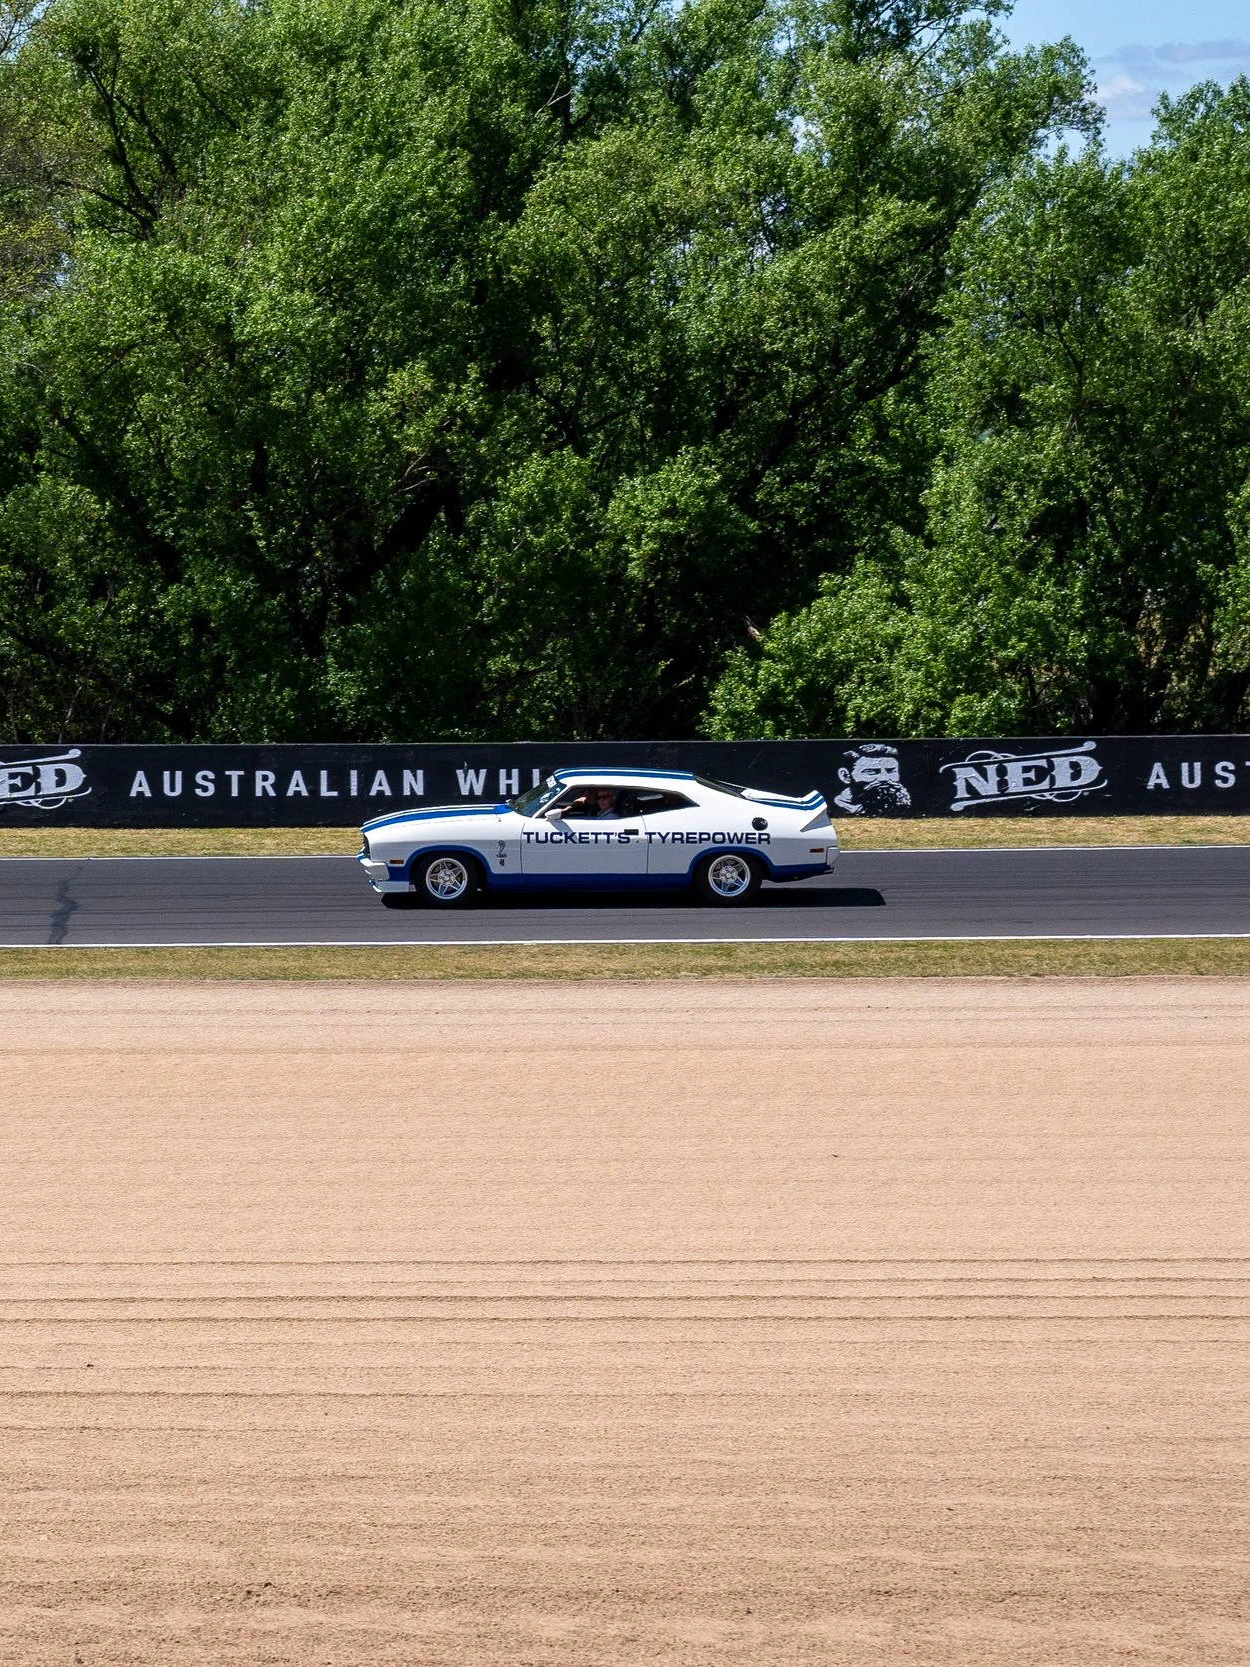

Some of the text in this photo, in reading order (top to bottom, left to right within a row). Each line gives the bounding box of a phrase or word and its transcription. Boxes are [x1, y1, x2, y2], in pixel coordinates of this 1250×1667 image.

[129, 769, 425, 797] AUSTRALIAN
[456, 768, 541, 796] WHI
[952, 755, 1104, 799] NED
[523, 832, 771, 845] TUCKETT'S TYREPOWER
